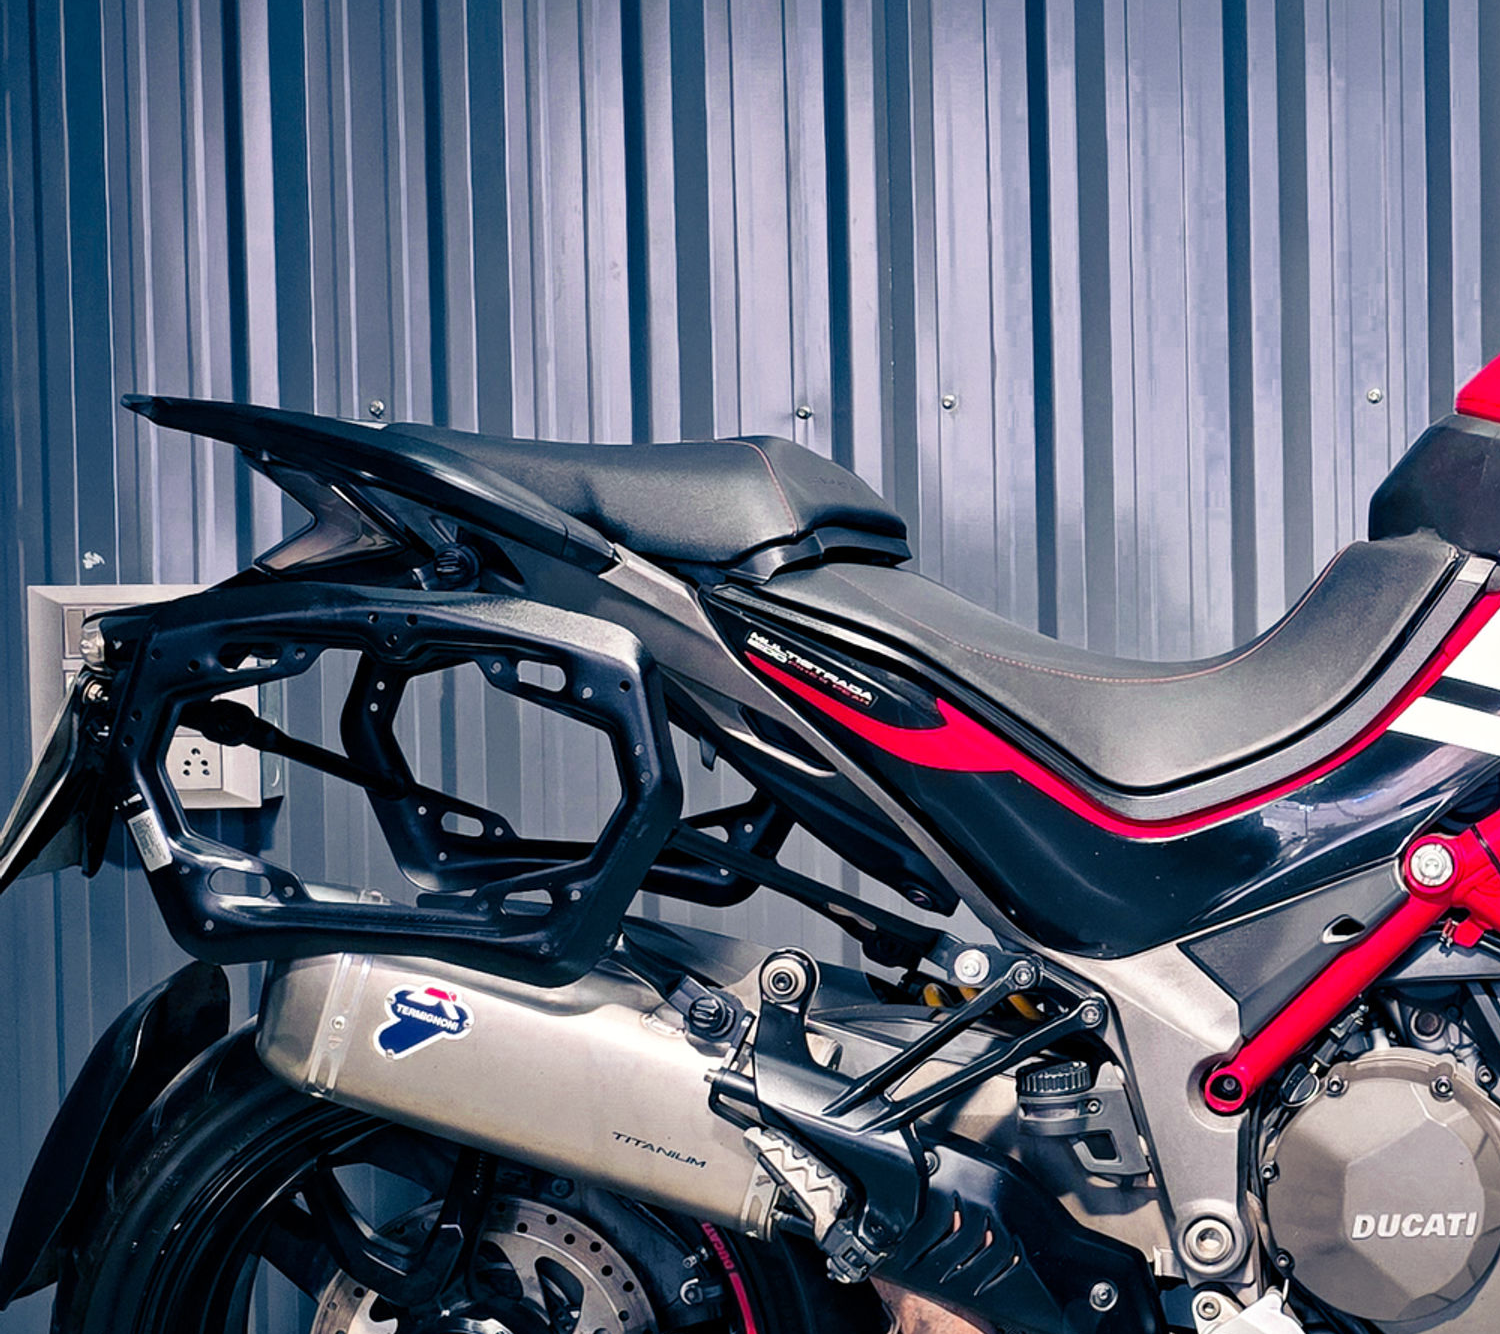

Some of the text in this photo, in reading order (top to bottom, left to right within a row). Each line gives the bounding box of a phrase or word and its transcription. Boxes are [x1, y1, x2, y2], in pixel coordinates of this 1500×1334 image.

[396, 1003, 460, 1031] TERMIGNONI
[612, 1131, 708, 1169] TITANIUM
[1351, 1211, 1478, 1239] DUCATI
[701, 1222, 735, 1270] DUCATI
